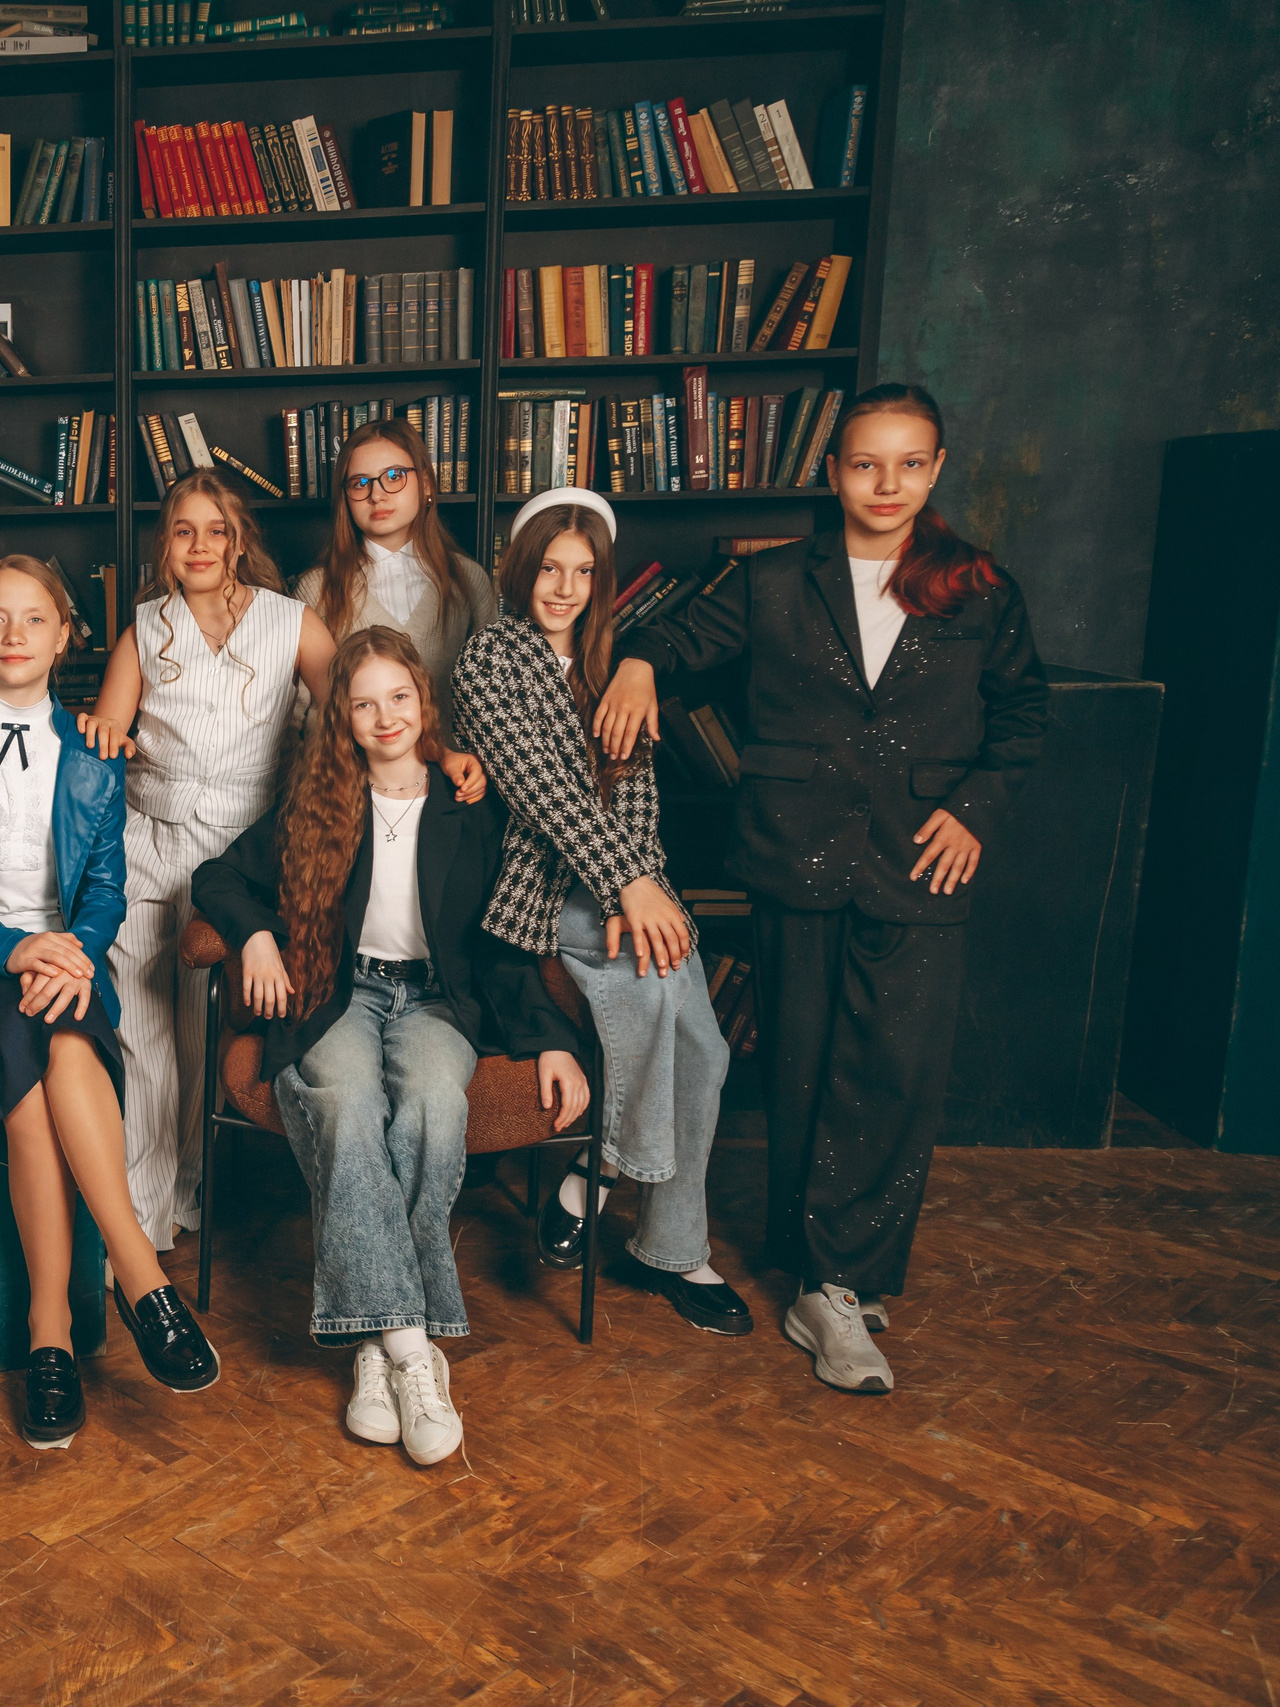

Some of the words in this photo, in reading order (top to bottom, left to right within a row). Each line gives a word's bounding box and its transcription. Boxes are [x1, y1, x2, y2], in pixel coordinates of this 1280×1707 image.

[537, 13, 542, 22] 2
[549, 12, 554, 20] 2
[600, 6, 605, 15] 6
[759, 113, 767, 123] 2
[775, 108, 783, 119] 1
[624, 110, 635, 136] SIDE
[325, 140, 350, 199] СПРАВОЧНИК
[734, 320, 743, 351] WALK
[627, 406, 633, 415] S
[767, 404, 777, 430] TITAN
[72, 421, 78, 429] S
[522, 409, 530, 437] WALK
[631, 427, 639, 453] Crossing
[57, 432, 66, 481] BRIDLEWAY
